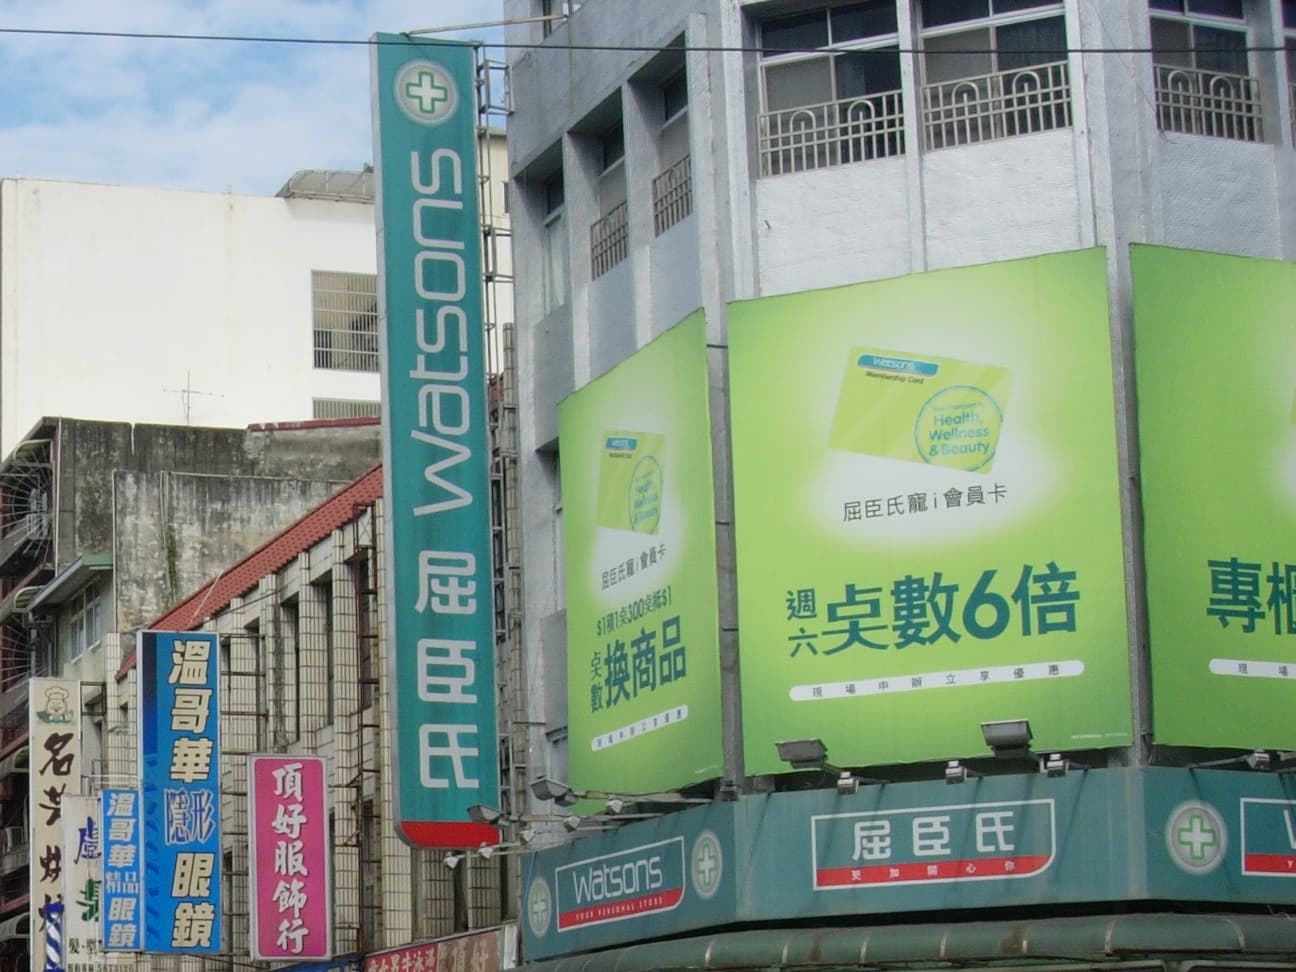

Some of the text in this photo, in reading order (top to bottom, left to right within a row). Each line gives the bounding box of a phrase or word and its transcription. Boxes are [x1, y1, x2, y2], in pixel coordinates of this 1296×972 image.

[410, 148, 473, 517] Watsons
[928, 426, 990, 442] Wellness
[942, 441, 991, 456] Beauty
[415, 550, 480, 789] 屈臣氏
[605, 615, 687, 709] 換商品
[271, 762, 309, 954] 頂好服飾行
[852, 811, 1015, 861] 屈臣氏
[573, 856, 663, 904] Watsons
[575, 897, 664, 921] YOUR PERSONAL STORE
